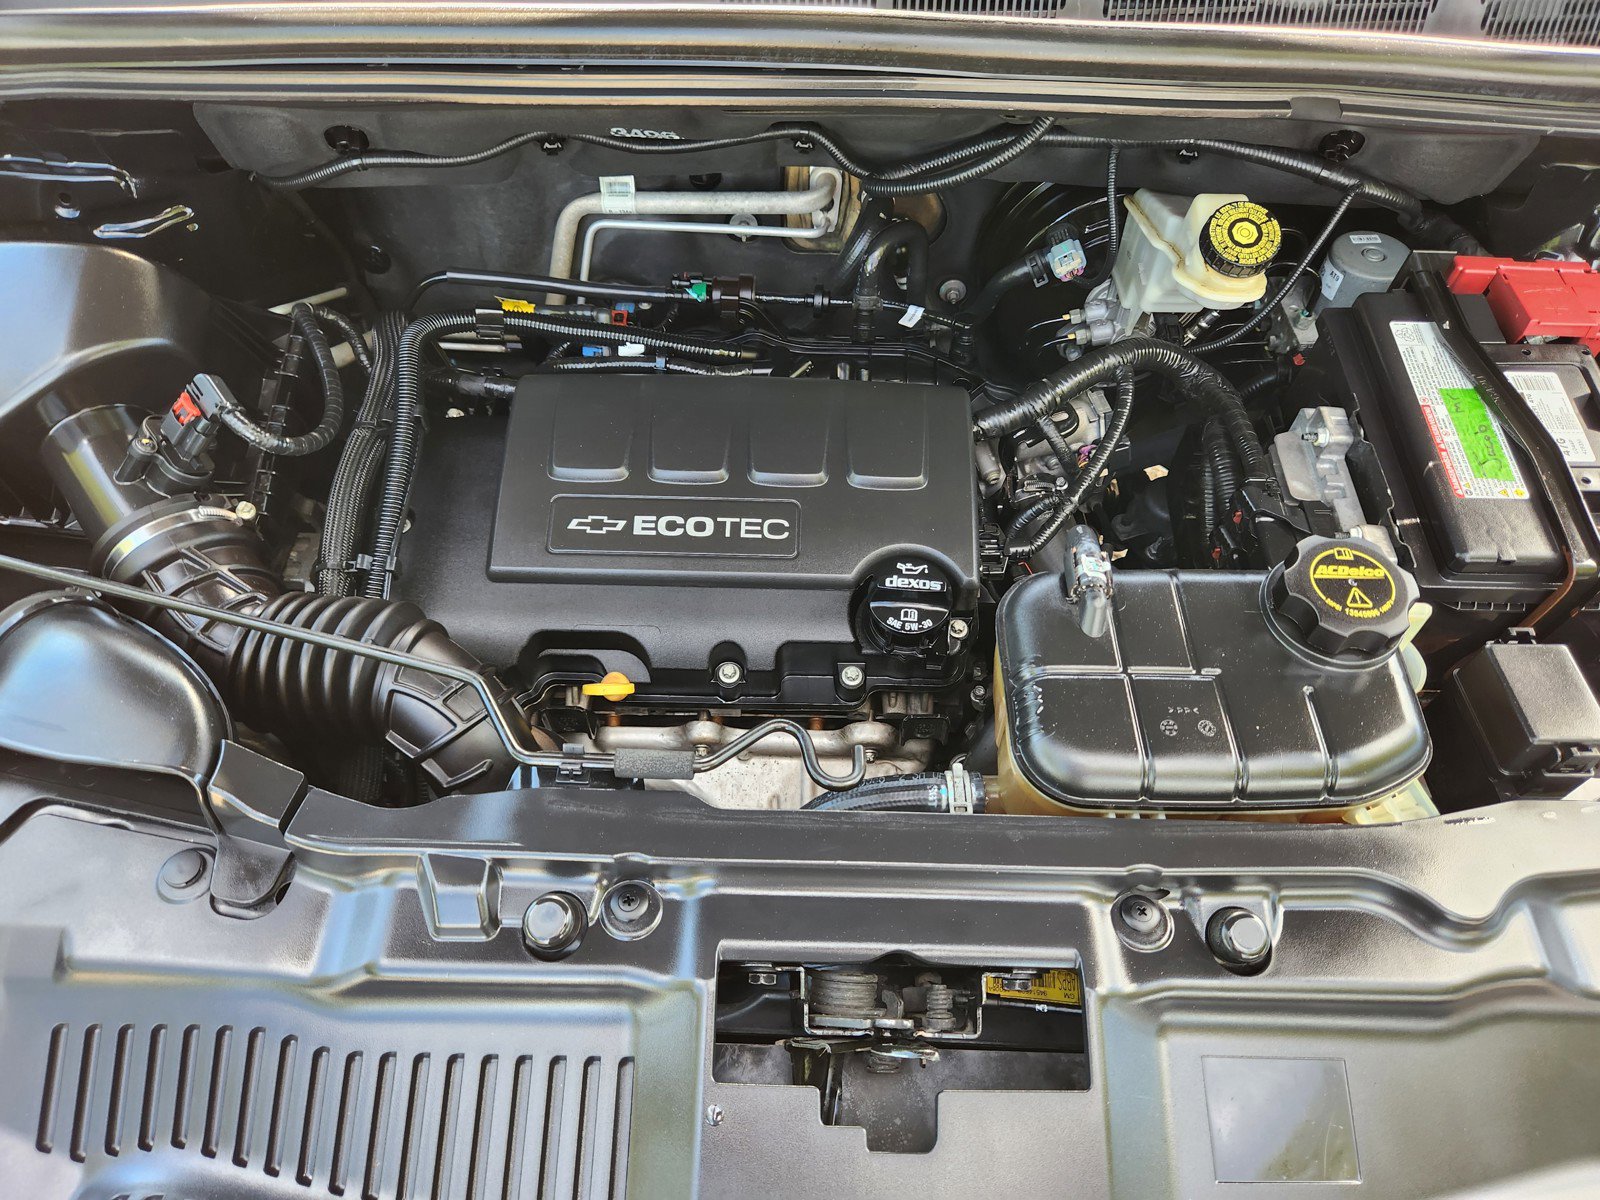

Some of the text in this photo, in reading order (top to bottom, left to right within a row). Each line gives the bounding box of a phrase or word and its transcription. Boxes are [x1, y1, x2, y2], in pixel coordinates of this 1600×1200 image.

[633, 515, 790, 540] ECOTEC
[1315, 564, 1385, 577] ACDelco
[885, 575, 944, 590] dexos
[886, 616, 933, 631] SAE 5W-30
